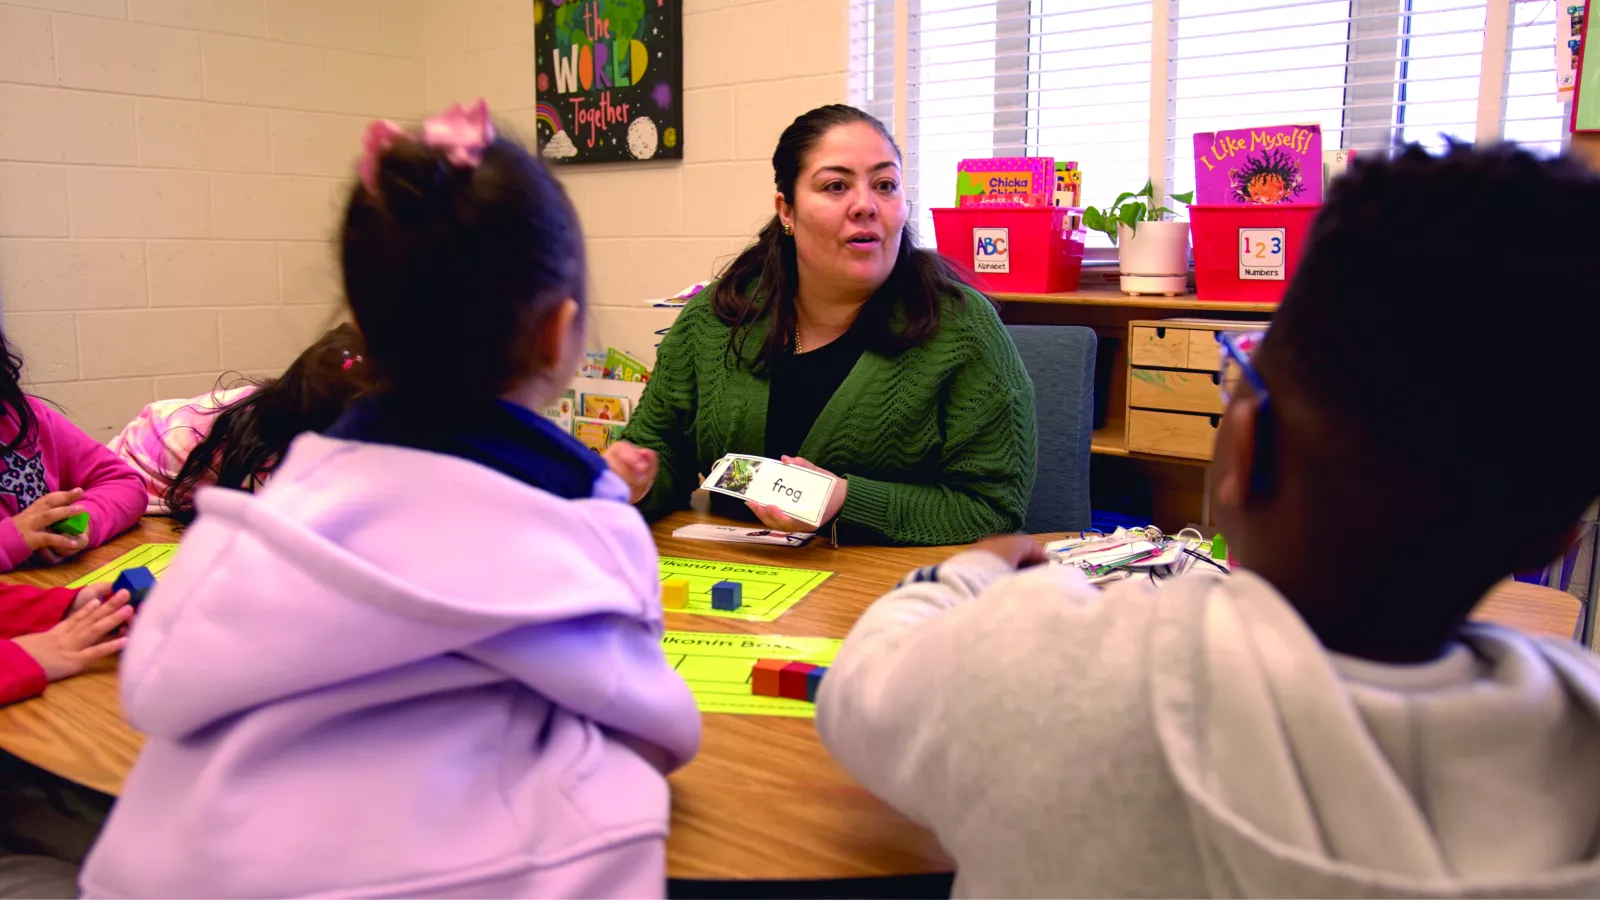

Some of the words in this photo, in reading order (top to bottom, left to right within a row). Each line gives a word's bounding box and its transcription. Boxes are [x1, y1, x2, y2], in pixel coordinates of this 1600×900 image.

[583, 0, 610, 41] the
[552, 39, 649, 94] WORLD
[569, 91, 630, 148] Together
[1200, 155, 1215, 171] I
[1211, 136, 1247, 161] Like
[1249, 128, 1313, 155] Myself!
[989, 177, 1028, 188] Chicka
[976, 236, 1008, 256] ABC
[1244, 237, 1251, 254] 1
[1255, 241, 1266, 259] 2
[1270, 236, 1281, 255] 3
[771, 478, 803, 503] frog
[720, 565, 779, 576] Boxes
